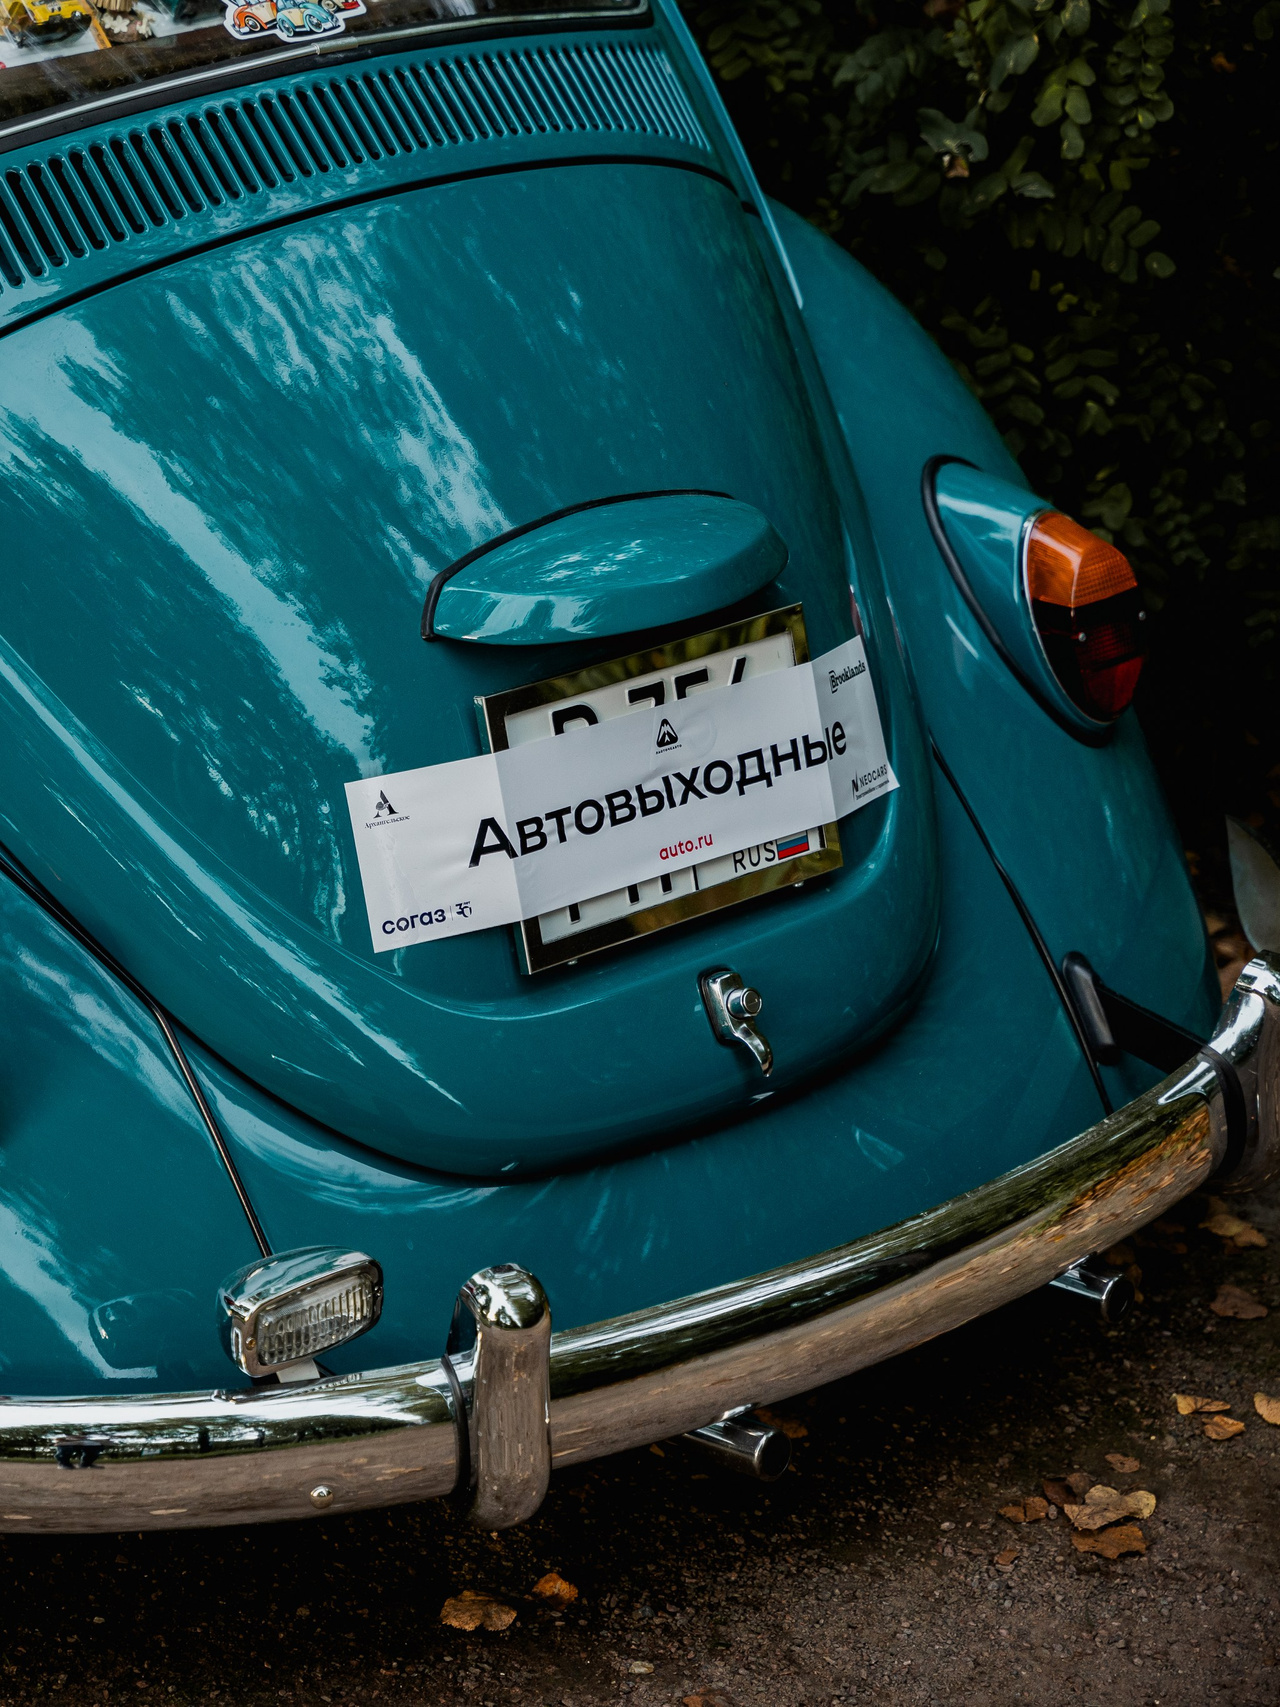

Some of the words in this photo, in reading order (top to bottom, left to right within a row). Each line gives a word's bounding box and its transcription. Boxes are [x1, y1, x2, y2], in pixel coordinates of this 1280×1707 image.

[829, 660, 867, 694] Brooklands
[859, 764, 888, 788] NEOCARS
[468, 720, 847, 868] Автовыходные
[364, 815, 411, 830] Архангельское
[658, 833, 714, 861] auto.ru
[732, 841, 776, 873] RUS
